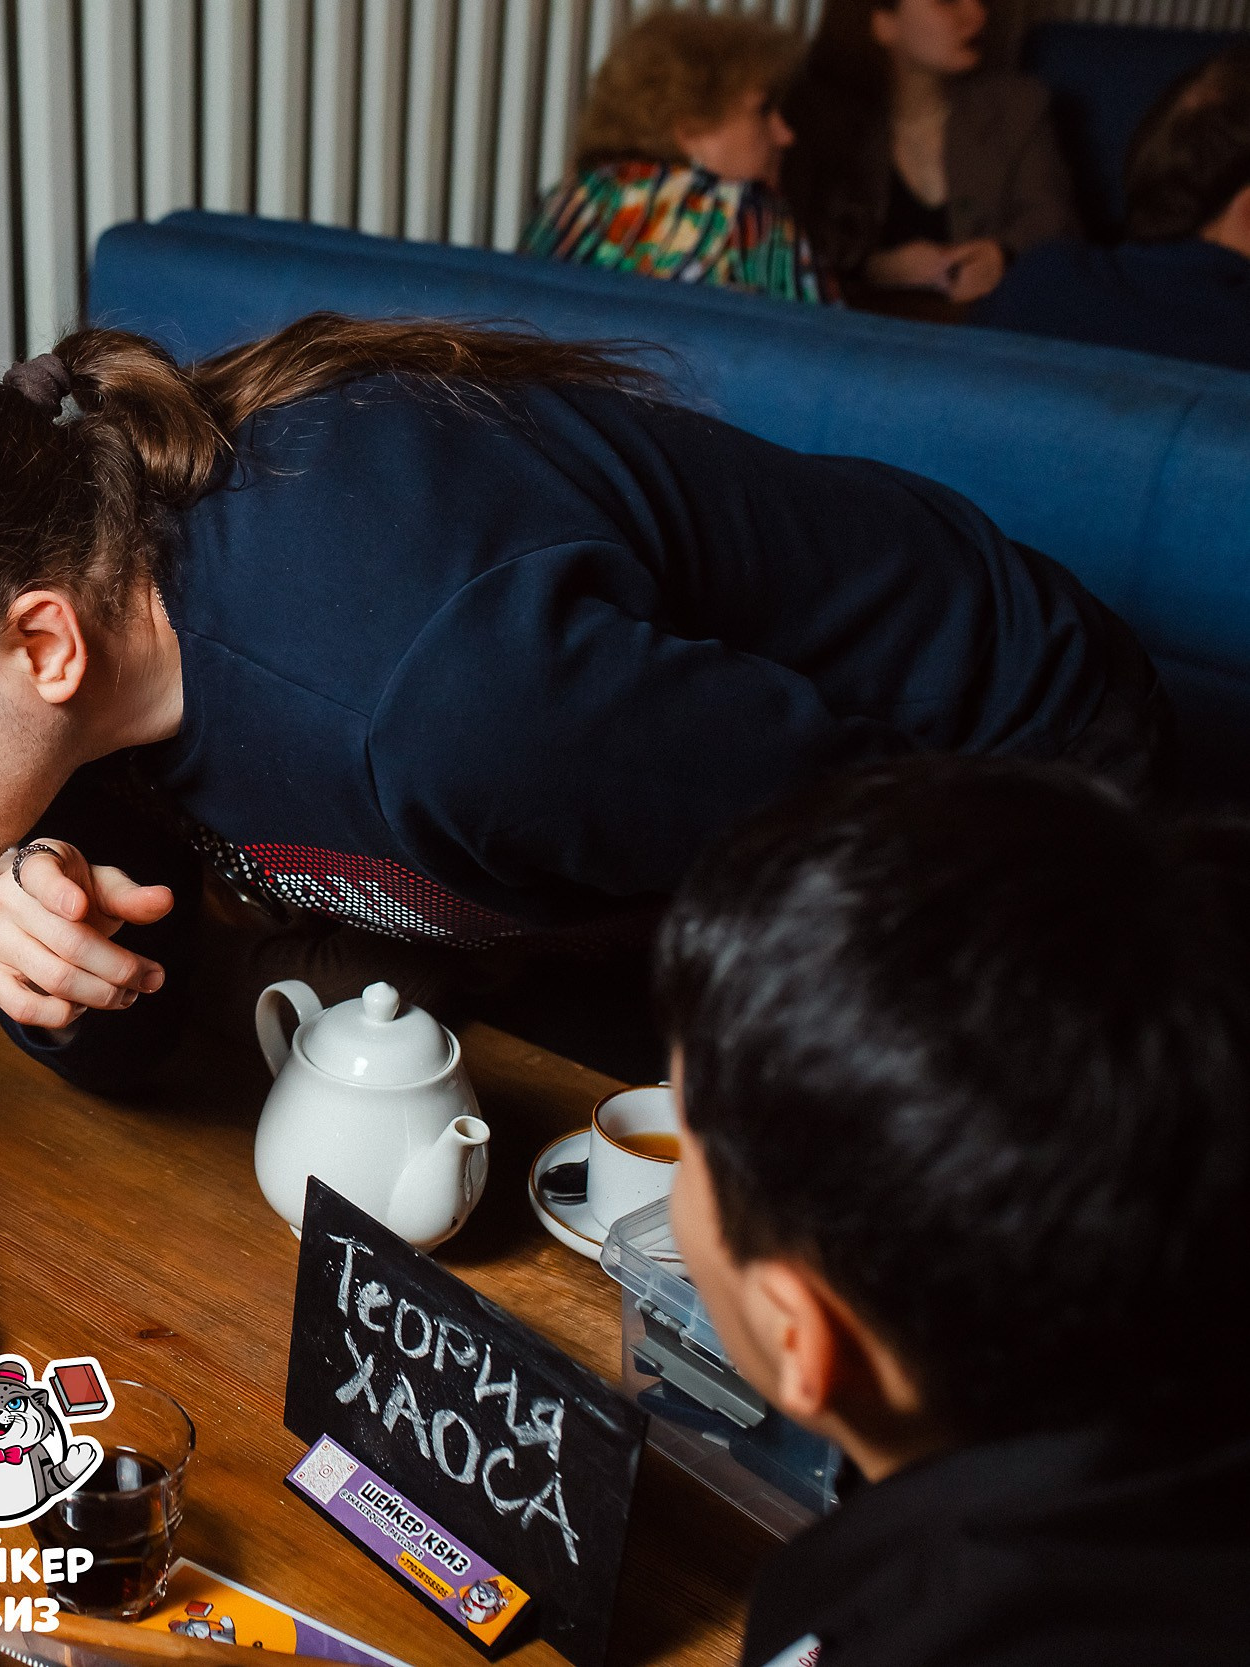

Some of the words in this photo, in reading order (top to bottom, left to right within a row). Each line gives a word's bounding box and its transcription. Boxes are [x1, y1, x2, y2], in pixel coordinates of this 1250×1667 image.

[334, 1329, 580, 1566] ХАОСА
[359, 1482, 424, 1538] ШЕЙКЕР
[423, 1526, 471, 1575] КВИЗ
